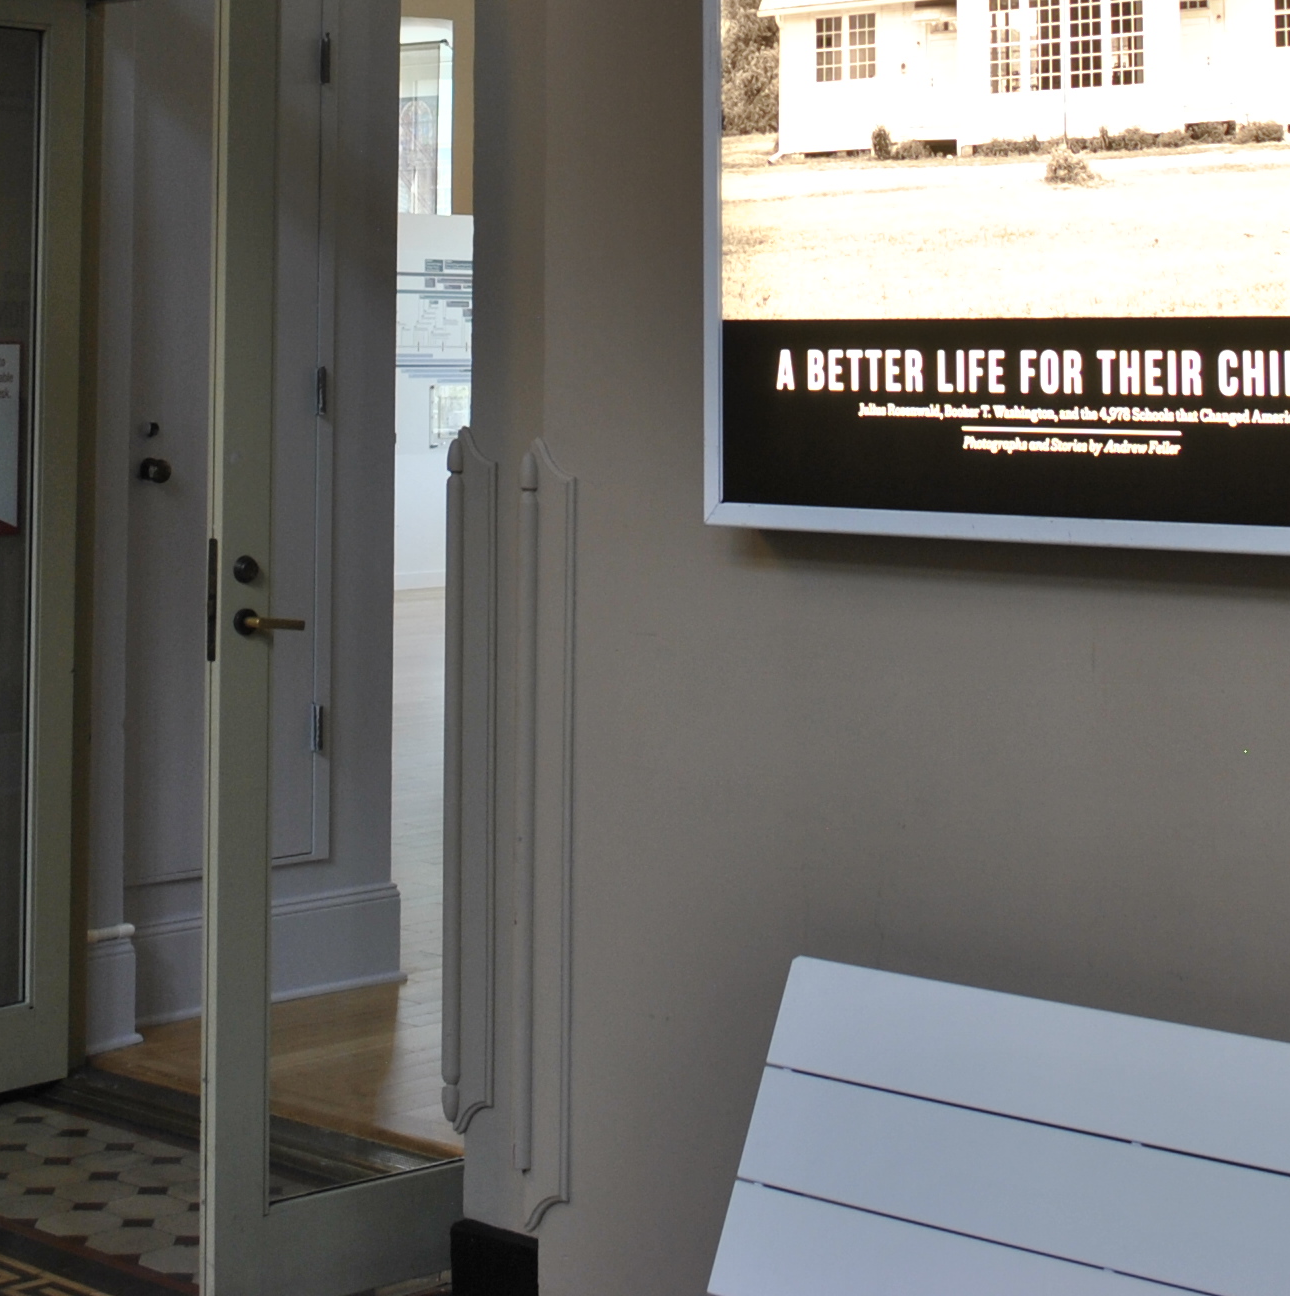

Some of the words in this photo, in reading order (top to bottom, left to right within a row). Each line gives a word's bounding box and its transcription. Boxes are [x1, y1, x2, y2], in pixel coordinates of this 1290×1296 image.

[776, 349, 795, 390] A
[807, 349, 923, 392] BETTER
[937, 350, 1005, 394] LIFE
[1020, 349, 1083, 394] FOR
[1096, 350, 1203, 396] THEIR
[858, 402, 886, 417] Julius
[886, 403, 944, 420] Rosenwald,
[944, 404, 980, 418] Booker
[980, 405, 992, 418] T.
[992, 405, 1059, 424] Washington,
[1059, 406, 1080, 420] and
[1080, 406, 1098, 421] the
[1099, 407, 1131, 424] 4,978
[1131, 407, 1175, 422] Schools
[1175, 408, 1199, 423] that
[1199, 408, 1251, 428] Changed
[963, 435, 1028, 454] Photographs
[1028, 438, 1050, 452] and
[1050, 438, 1088, 453] Stories
[1088, 439, 1103, 457] by
[1103, 439, 1147, 454] Andrew
